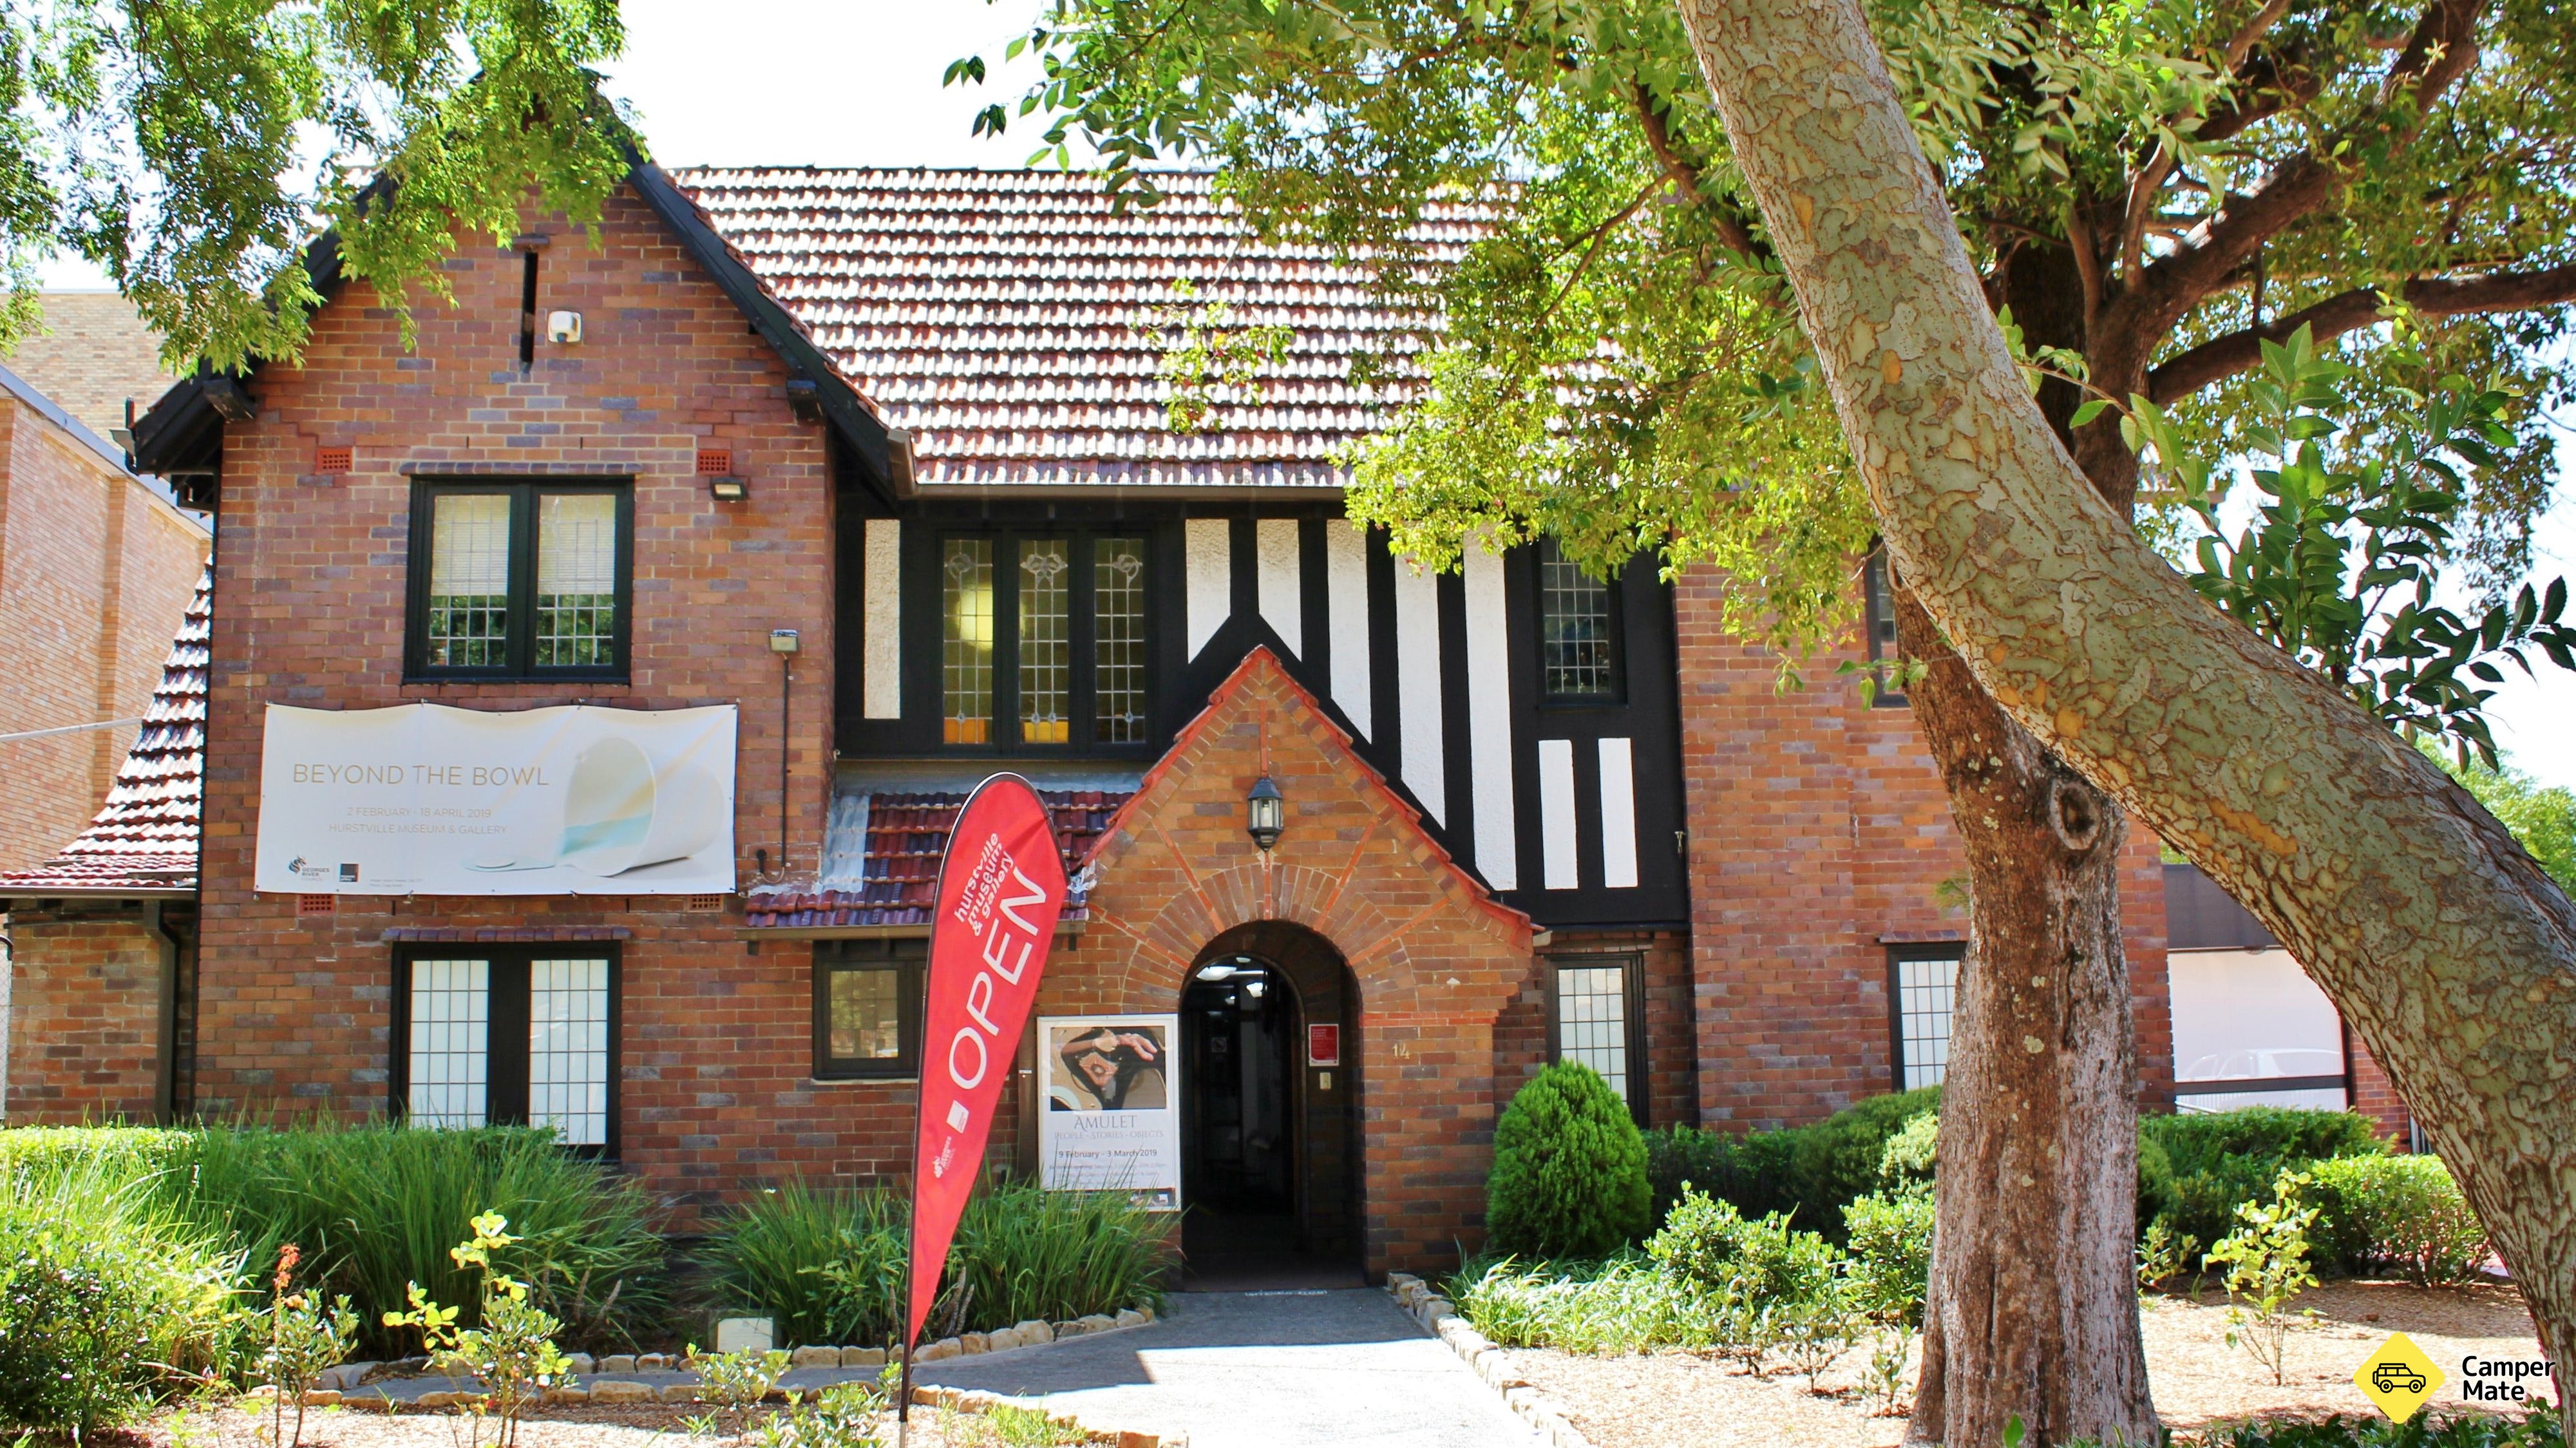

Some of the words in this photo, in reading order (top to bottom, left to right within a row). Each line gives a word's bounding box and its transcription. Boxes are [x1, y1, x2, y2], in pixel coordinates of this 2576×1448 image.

[293, 764, 404, 785] BEYOND
[413, 765, 462, 785] THE
[472, 767, 549, 786] BOWL
[347, 806, 354, 815] 2
[356, 807, 412, 817] FEBRUARY
[421, 808, 431, 817] 18
[433, 808, 464, 818] APRIL
[468, 809, 491, 818] 2019
[329, 823, 395, 834] HURSTVILLE
[398, 824, 445, 834] MUSEUM
[448, 824, 455, 834] &
[459, 825, 507, 835] GALLERY
[954, 833, 999, 922] hurstville
[968, 843, 1002, 926] museum
[972, 919, 983, 936] &
[981, 850, 1014, 919] gallery
[949, 867, 1046, 1090] OPEN
[1392, 1042, 1410, 1060] 14
[1074, 1114, 1138, 1132] AMULET
[1091, 1130, 1124, 1139] STORIES
[1130, 1130, 1164, 1139] OBJECTS
[1066, 1149, 1100, 1160] February
[1114, 1148, 1138, 1157] March
[1140, 1148, 1158, 1157] 2019
